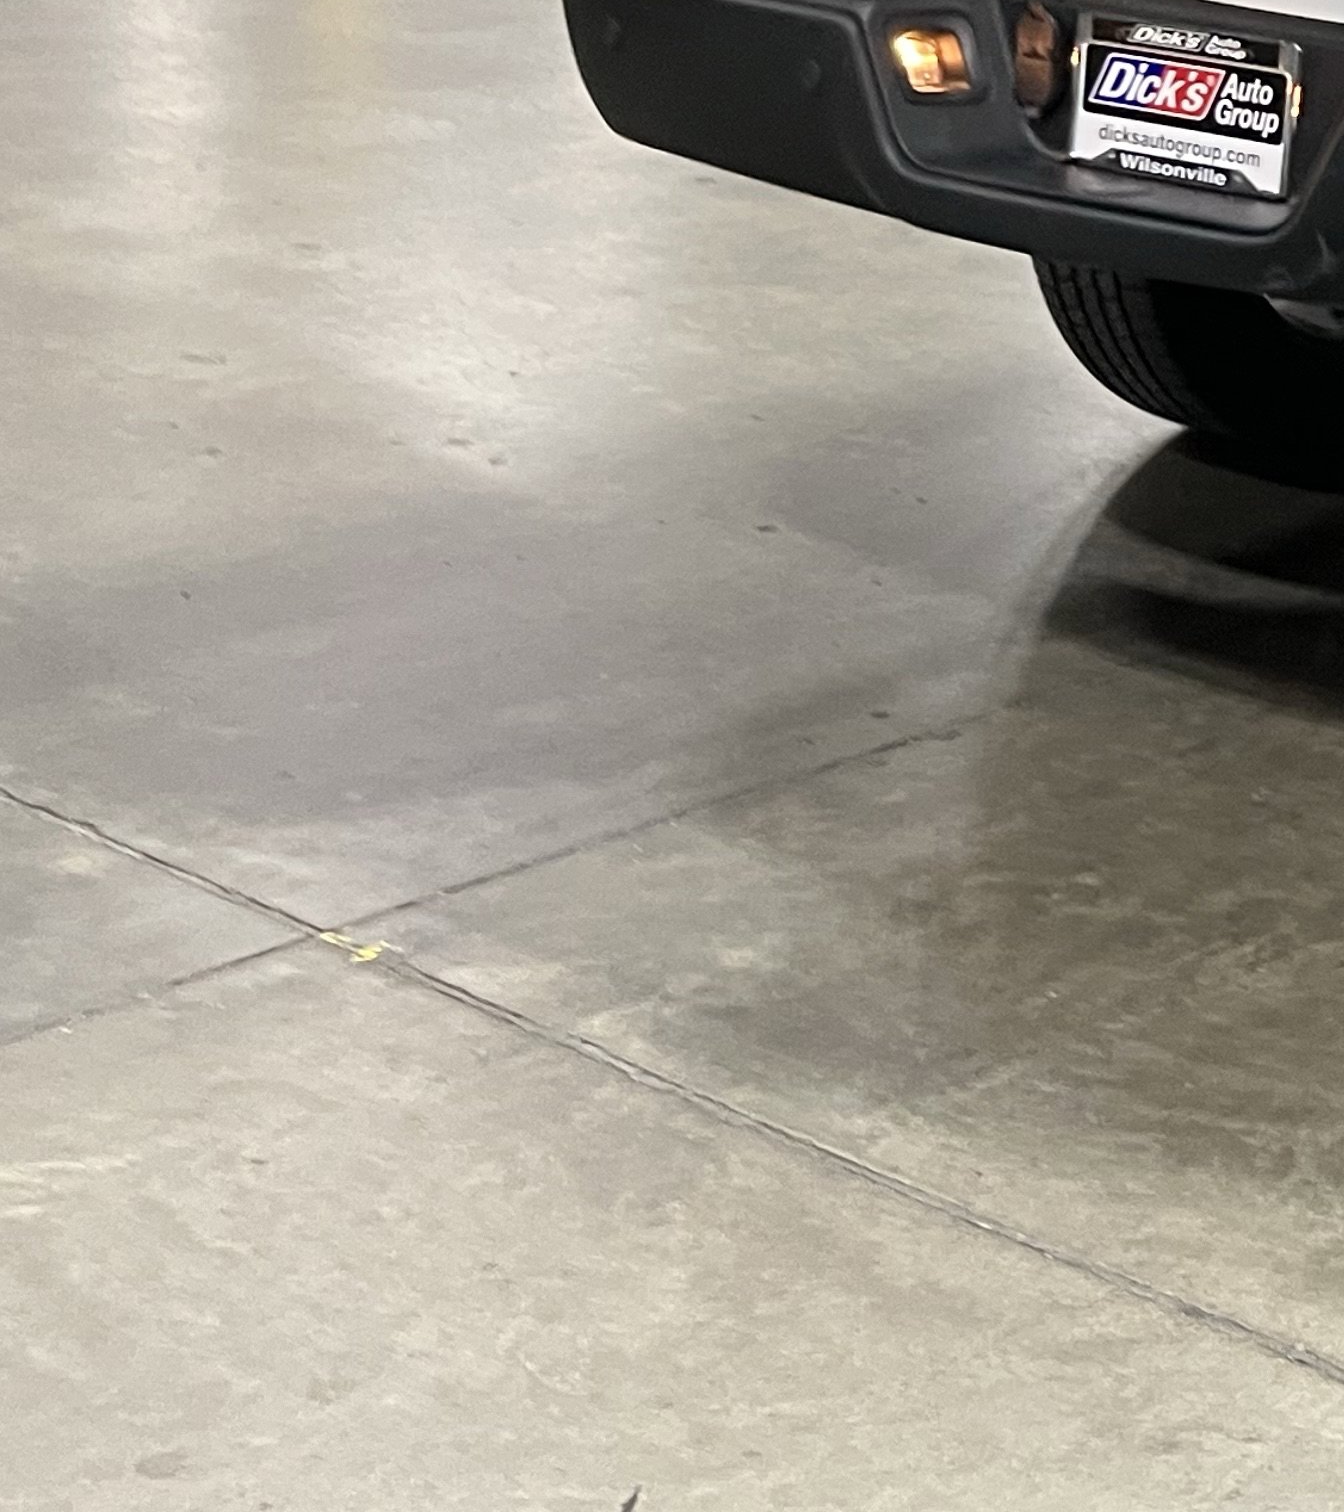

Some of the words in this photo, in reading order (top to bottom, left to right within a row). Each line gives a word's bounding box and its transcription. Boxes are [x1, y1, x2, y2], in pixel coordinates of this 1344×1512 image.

[1132, 25, 1201, 49] Dick's
[1098, 60, 1209, 112] Dick's
[1220, 73, 1274, 106] Auto
[1214, 98, 1280, 138] Group
[1098, 124, 1261, 168] dicksautogroup.com
[1119, 152, 1228, 186] Wilsonville
